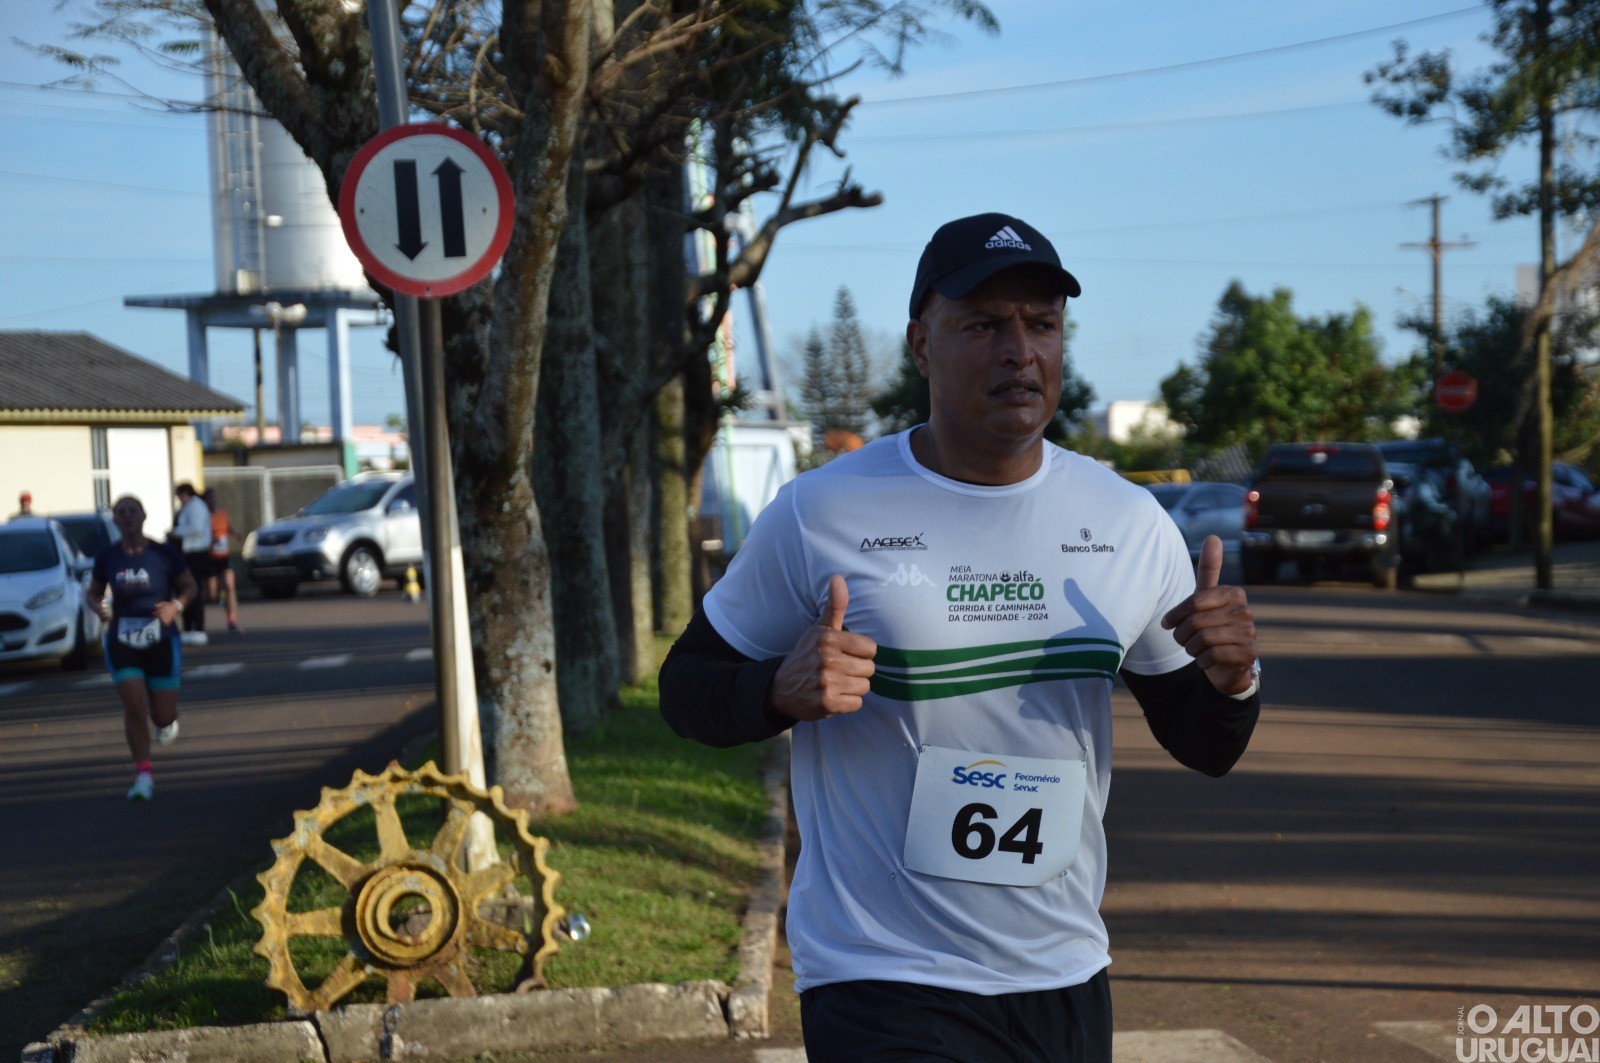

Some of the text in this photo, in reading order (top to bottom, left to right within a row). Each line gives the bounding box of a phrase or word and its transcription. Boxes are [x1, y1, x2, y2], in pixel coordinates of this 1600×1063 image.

[984, 239, 1032, 251] adidas
[1061, 543, 1115, 553] Banco Safra
[950, 565, 972, 574] MEIA
[949, 570, 1034, 582] MARATONA alfa
[946, 578, 1045, 602] CHAPECÓ
[948, 603, 1047, 612] CORRIDA E CAMINHADA
[948, 614, 960, 622] DA
[962, 613, 1020, 622] COMUNIDADE
[1027, 613, 1049, 621] 2024
[1014, 772, 1061, 784] Fecomércio
[1013, 783, 1039, 793] Senac
[951, 802, 1044, 865] 64
